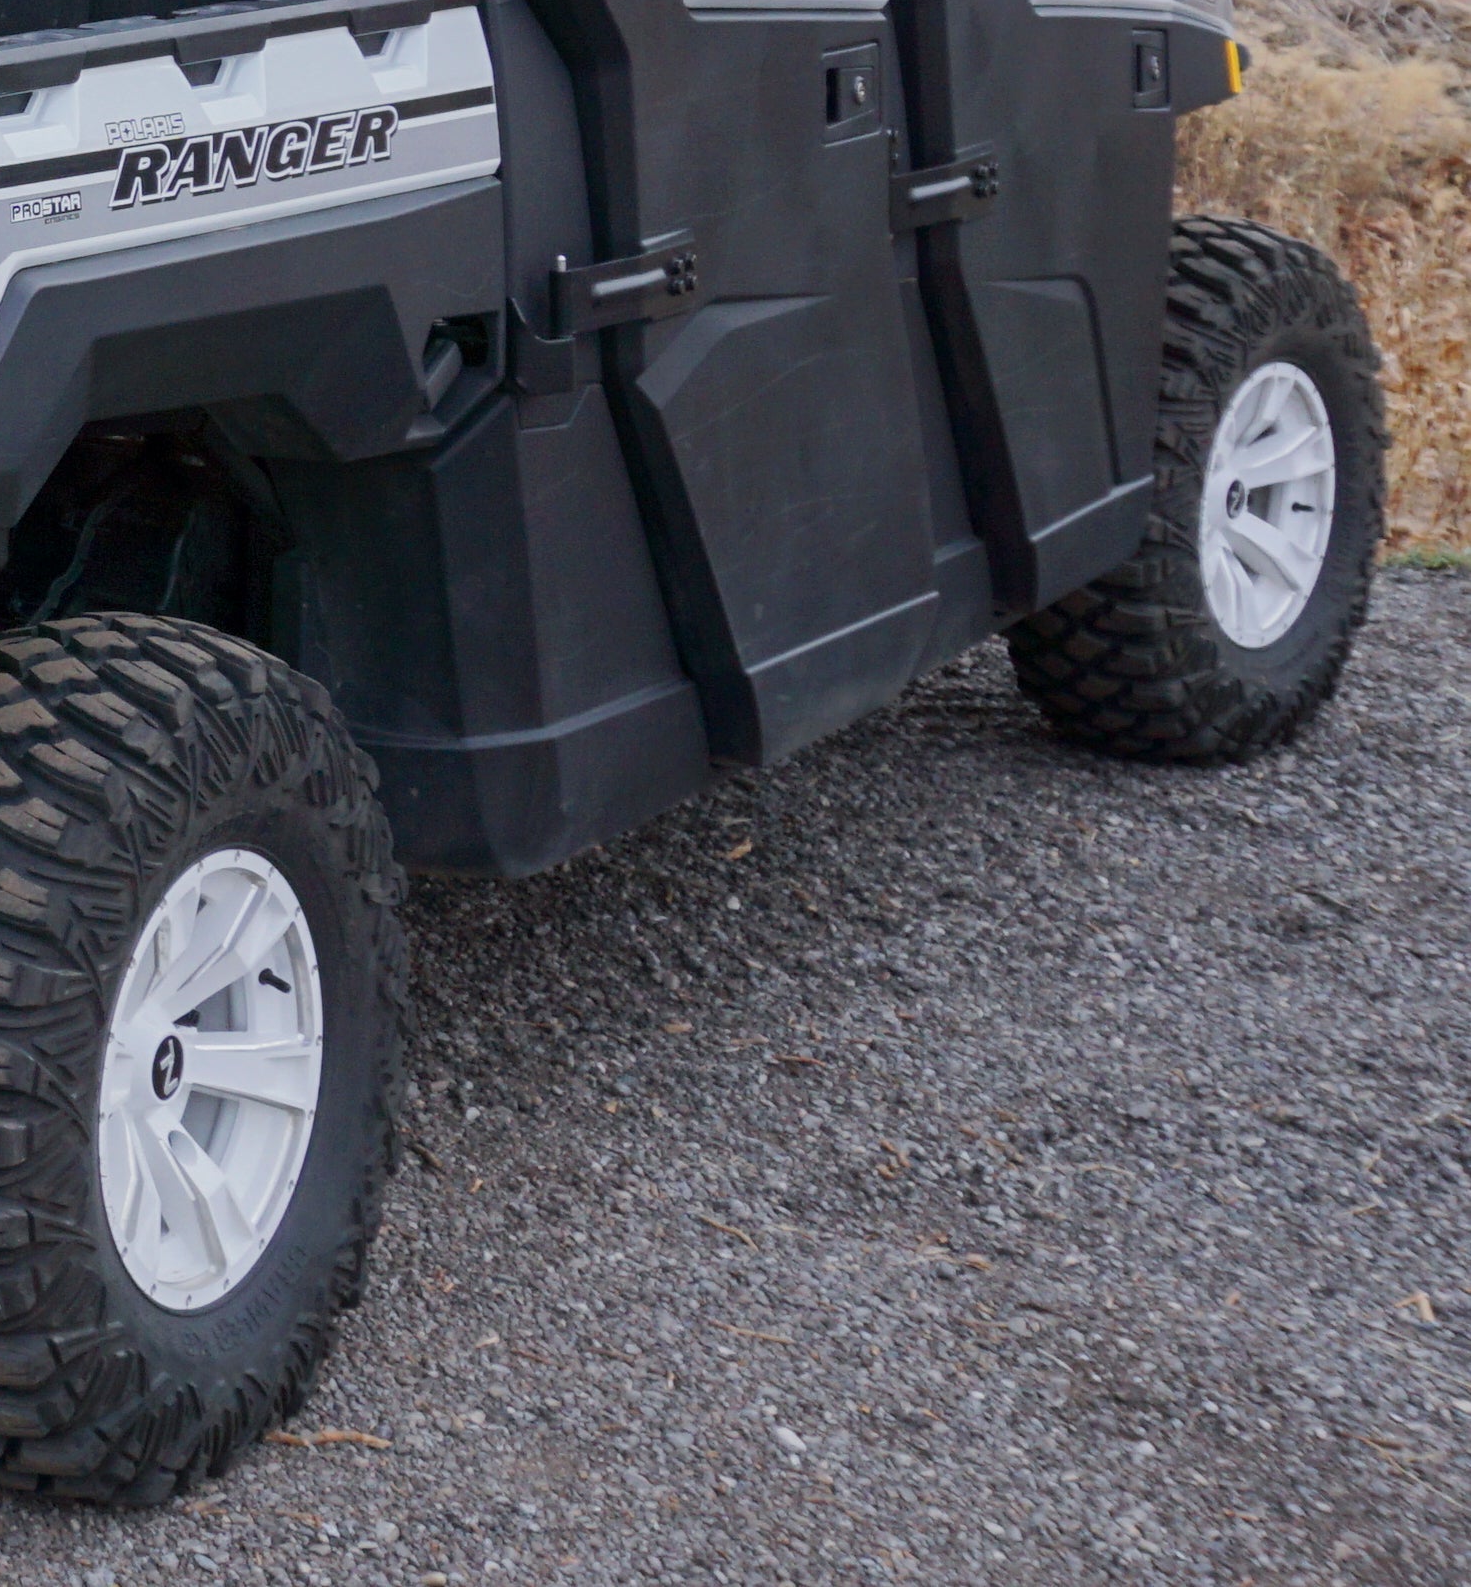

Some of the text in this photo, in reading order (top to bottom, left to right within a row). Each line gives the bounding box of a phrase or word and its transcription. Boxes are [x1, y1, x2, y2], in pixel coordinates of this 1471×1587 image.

[104, 112, 186, 146] POLARIS
[108, 104, 399, 210] RANGER
[11, 192, 82, 222] PROSTAR
